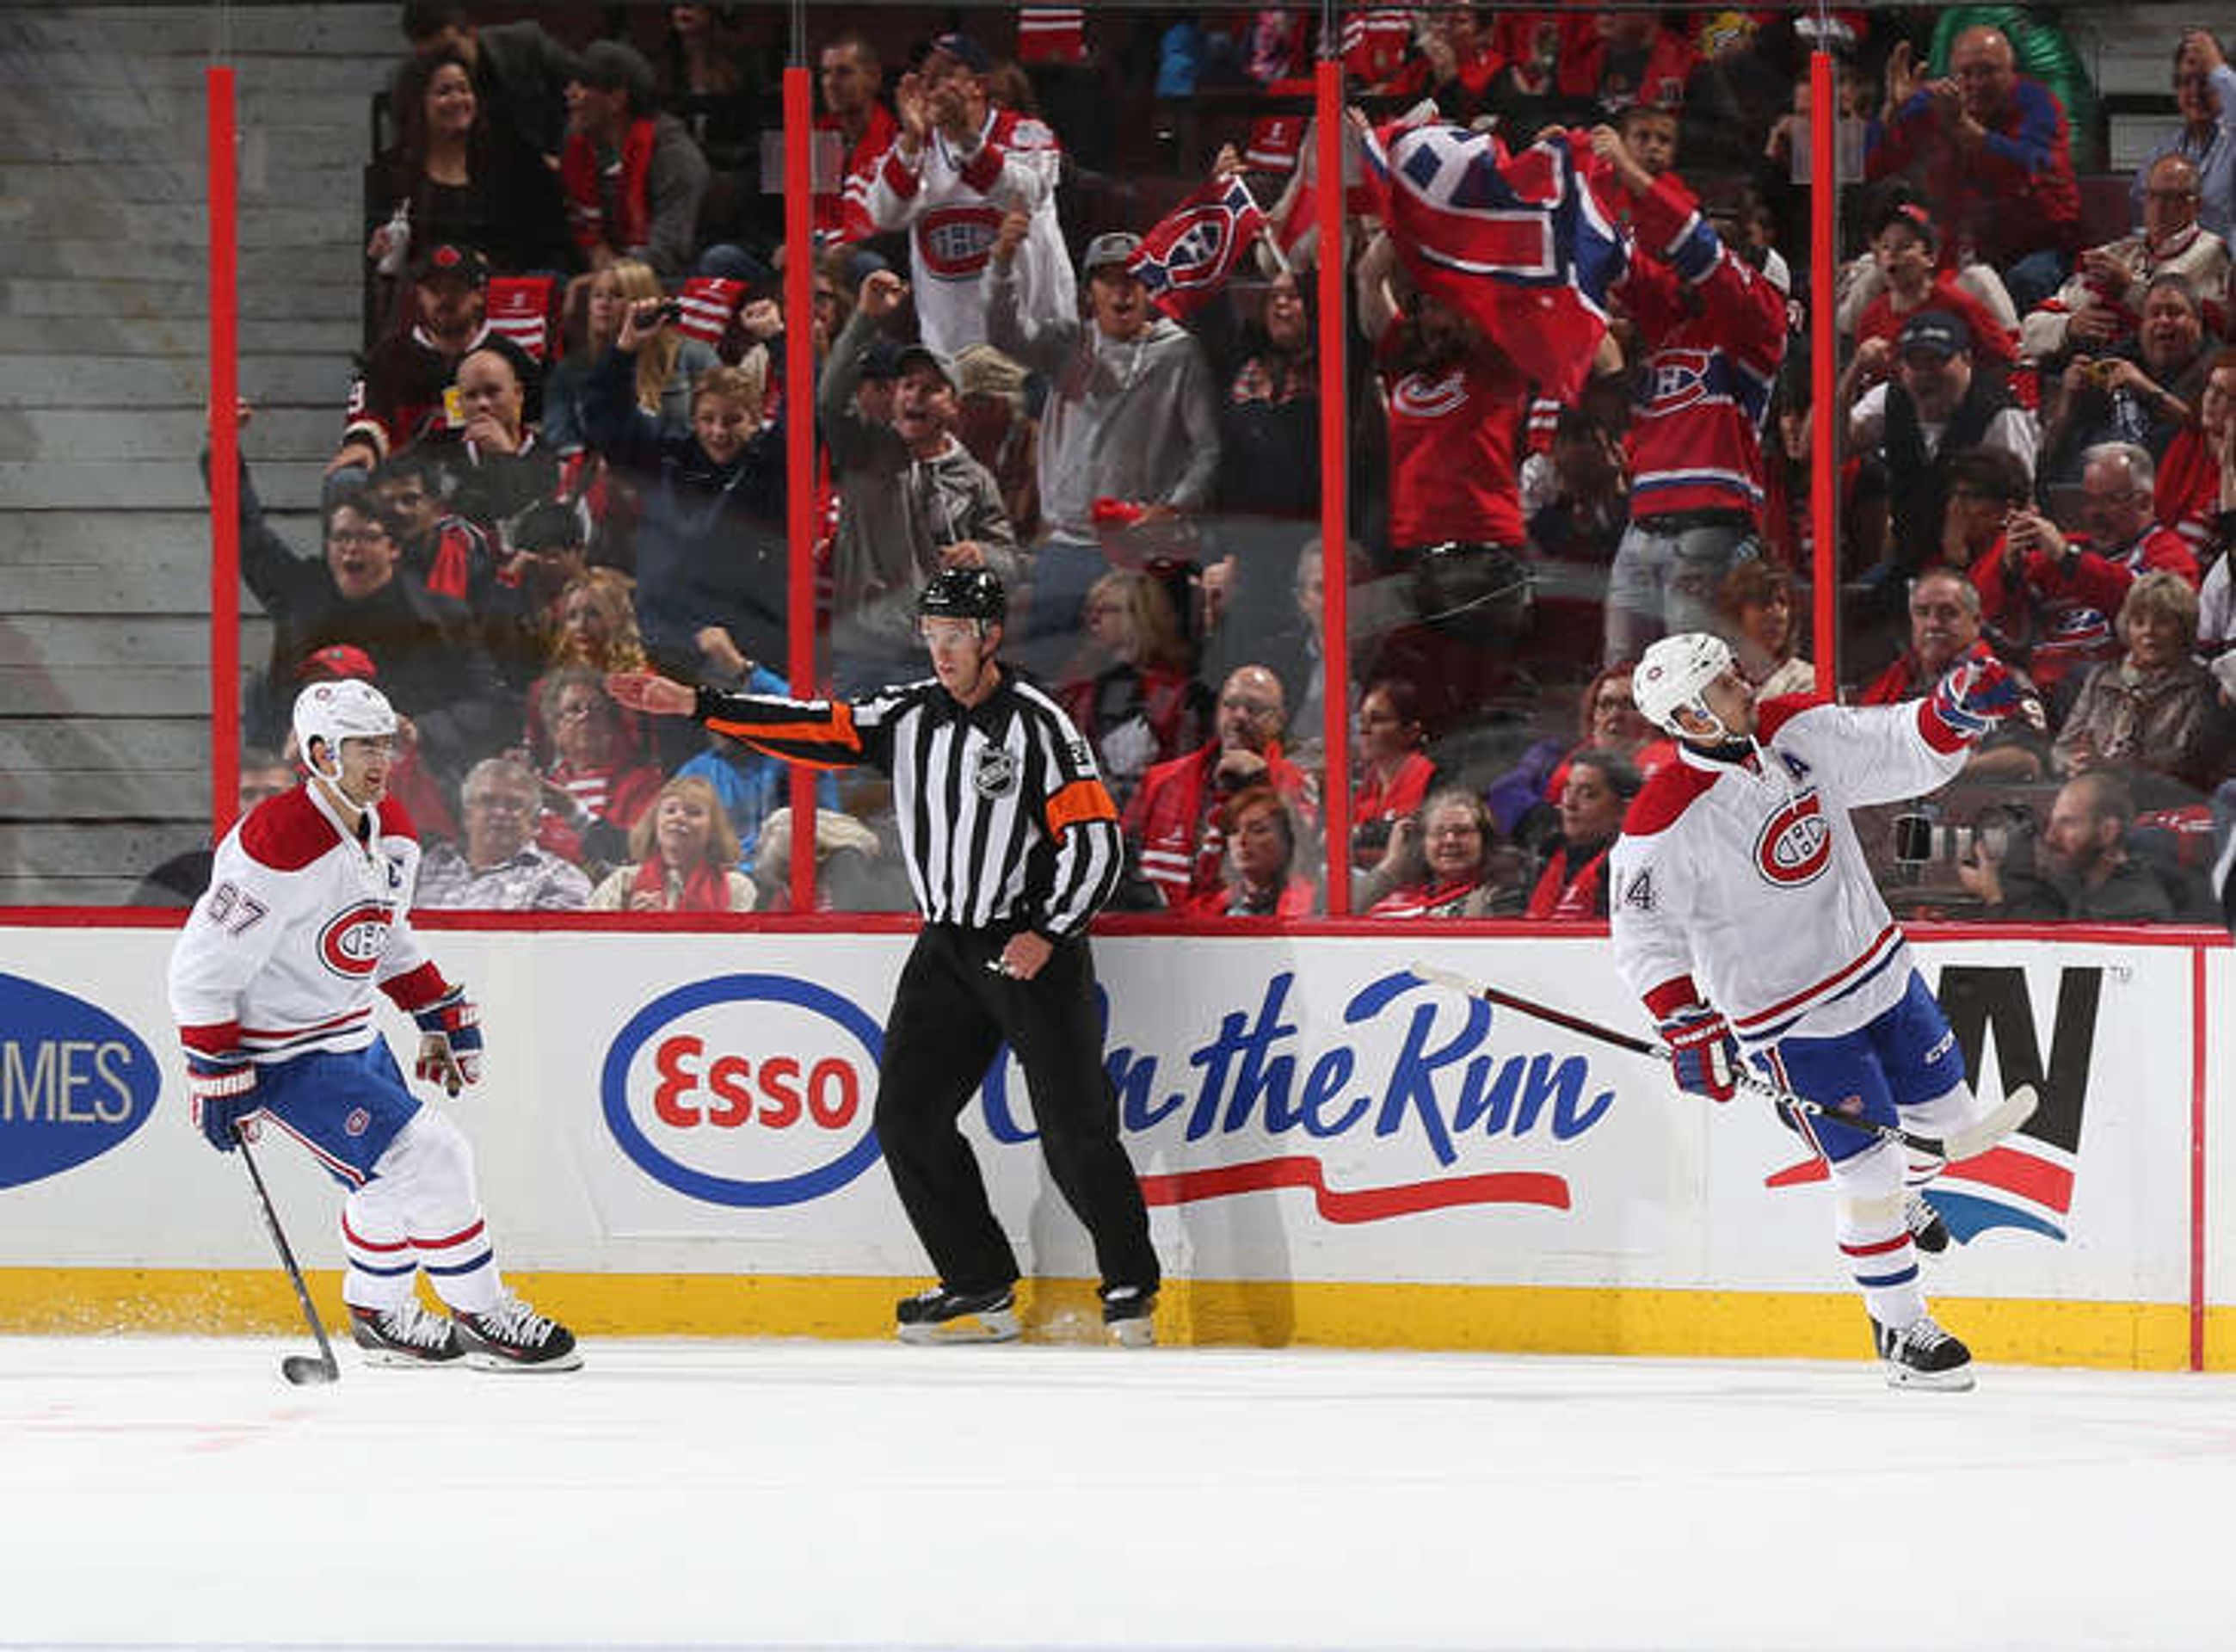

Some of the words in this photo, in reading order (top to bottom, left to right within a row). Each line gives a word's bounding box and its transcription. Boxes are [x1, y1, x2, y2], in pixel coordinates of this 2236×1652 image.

[1781, 752, 1812, 781] A
[388, 857, 404, 888] C
[3, 1039, 133, 1124] MES
[1186, 972, 1371, 1143] the
[1344, 969, 1616, 1167] Run
